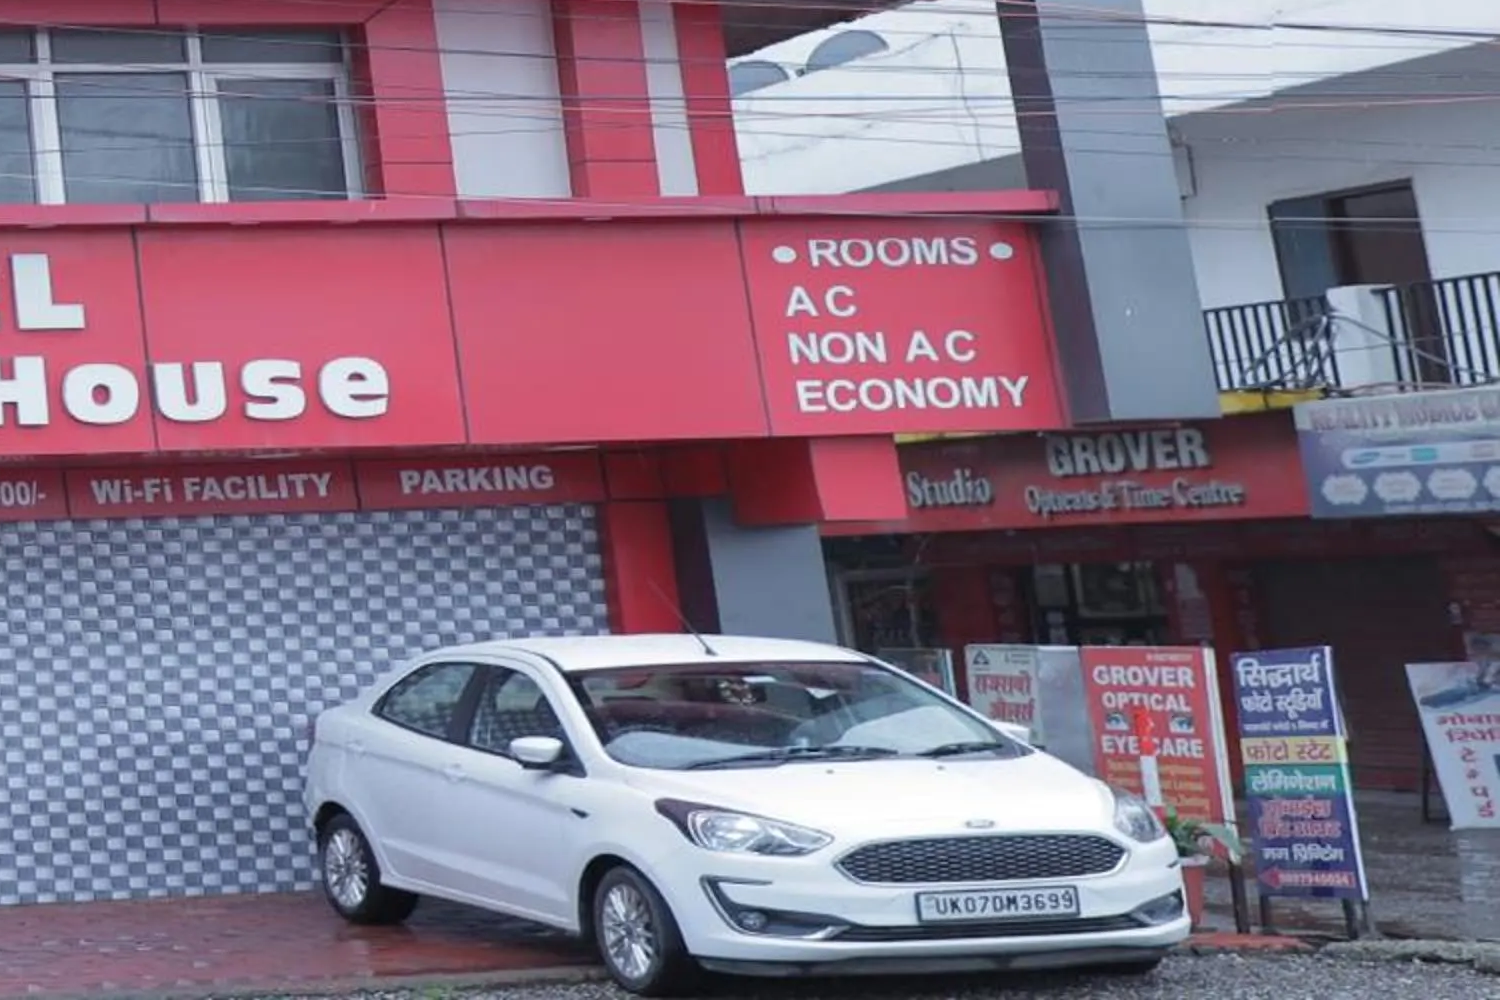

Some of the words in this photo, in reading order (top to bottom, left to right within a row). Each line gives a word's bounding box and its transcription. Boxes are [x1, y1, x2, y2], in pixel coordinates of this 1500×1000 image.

[808, 237, 979, 267] ROOMS
[787, 331, 887, 365] NON
[796, 376, 1029, 413] ECONOMY
[1048, 429, 1210, 477] GROVER
[90, 477, 173, 504] Wi-Fi
[183, 472, 332, 501] FACILITY
[400, 465, 555, 496] PARKING
[906, 468, 992, 508] Studio
[1172, 477, 1244, 506] Centre
[1092, 665, 1196, 688] GROVER
[1101, 691, 1192, 712] OPTICAL
[1101, 734, 1140, 754] EYE
[935, 893, 1074, 916] UK07DM3699
